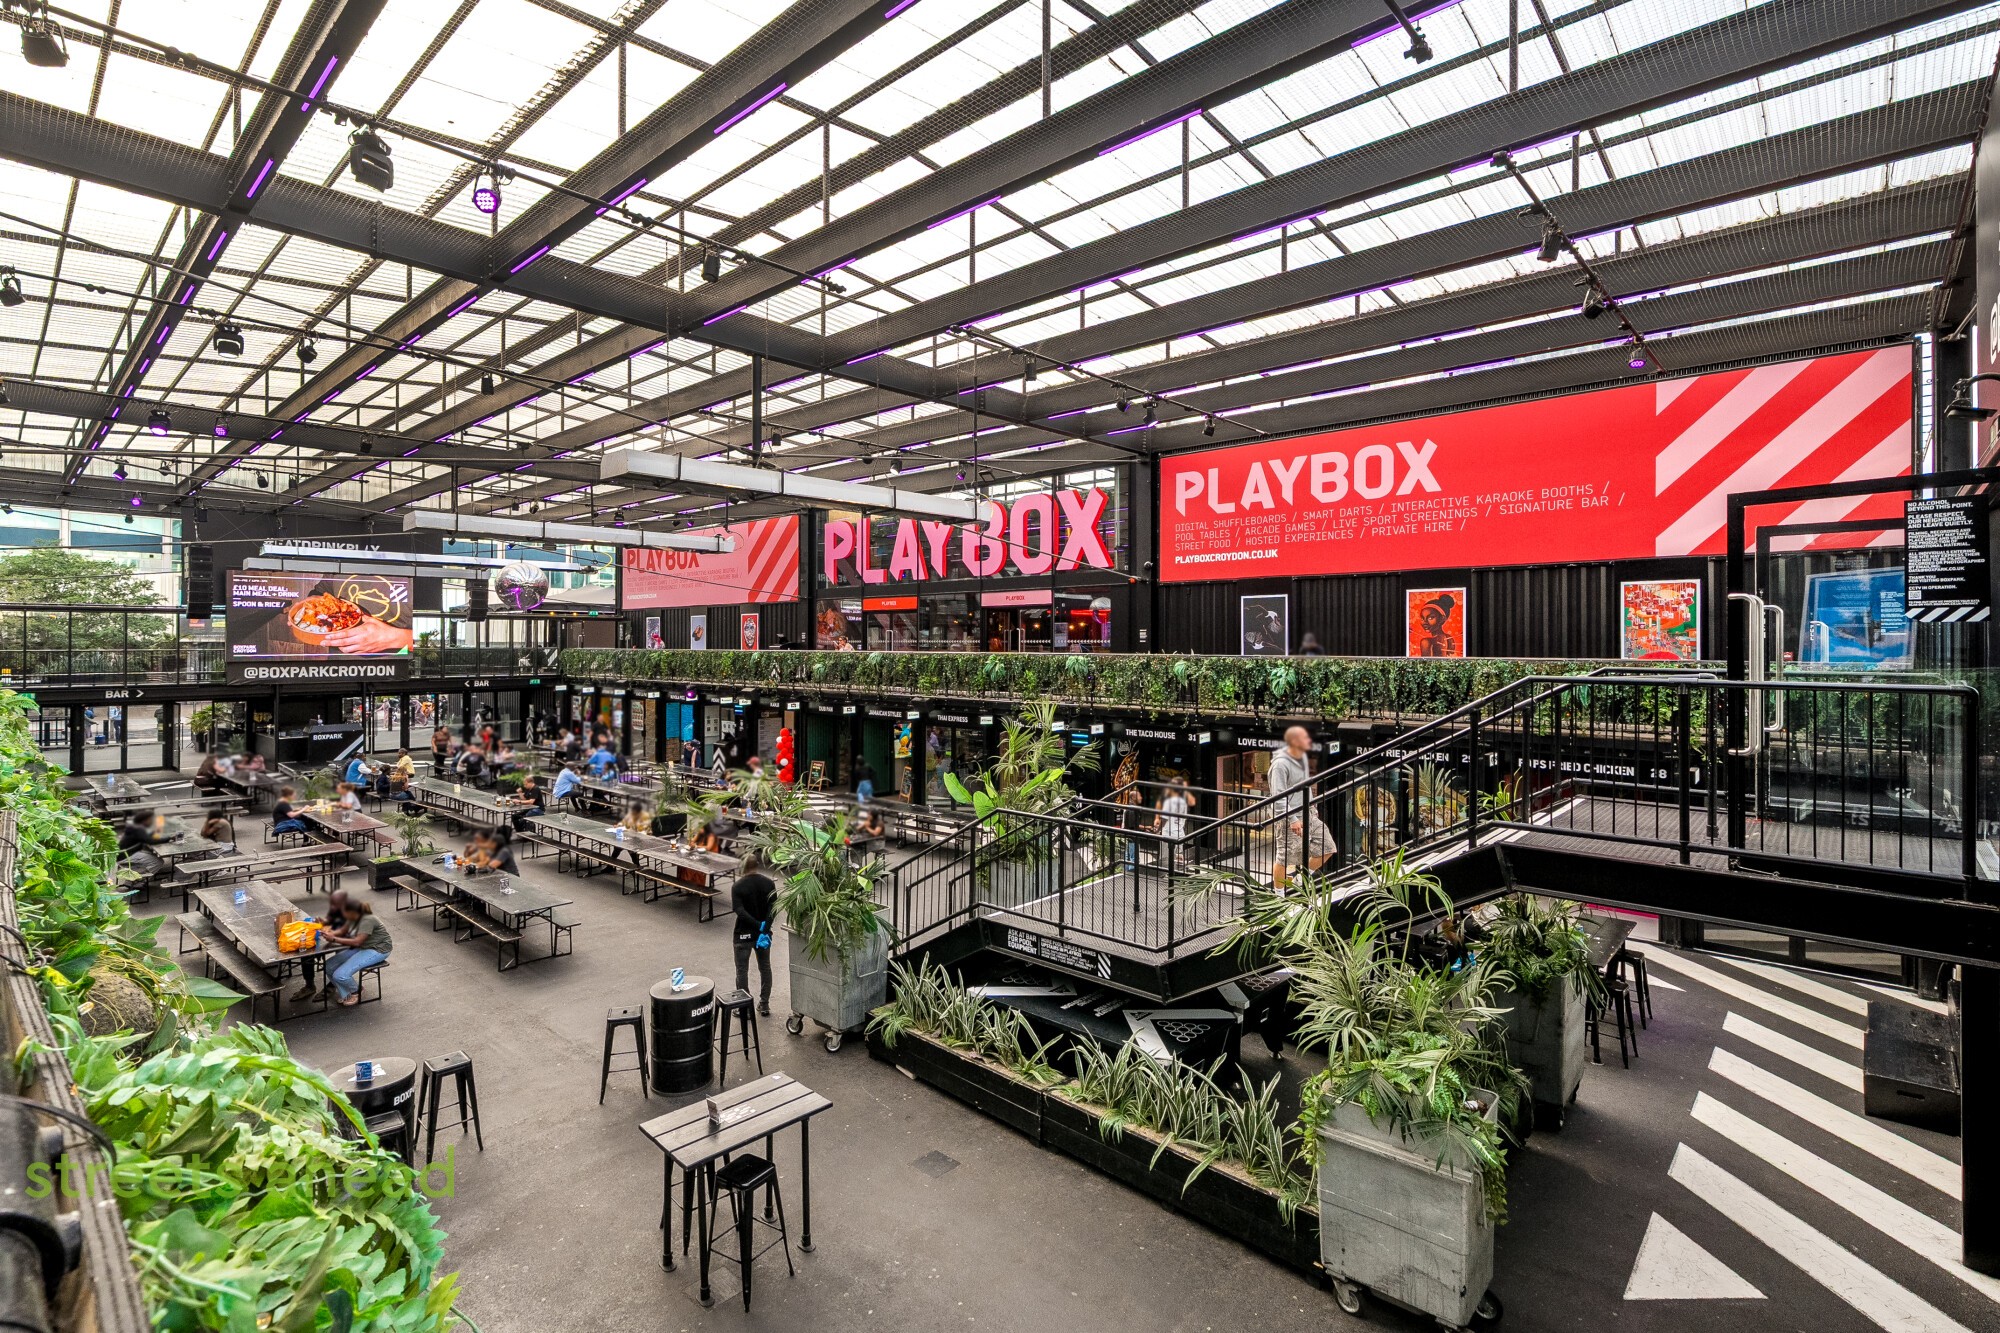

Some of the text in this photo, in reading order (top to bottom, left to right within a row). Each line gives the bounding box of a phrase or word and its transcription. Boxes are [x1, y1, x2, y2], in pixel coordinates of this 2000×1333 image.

[1176, 439, 1441, 516] PLAYBOX
[1175, 523, 1209, 532] DIGITAL
[1213, 514, 1287, 529] SHUFFLEBOARDS
[1303, 510, 1333, 521] SMART
[1340, 506, 1372, 518] DARTS
[1391, 496, 1469, 513] INTERACTIVE
[1476, 490, 1533, 504] KARAOKE
[1541, 484, 1593, 499] BOOTHS
[1175, 532, 1196, 541] POOL
[1199, 529, 1230, 540] TABLES
[1245, 525, 1280, 536] ARCADE
[1285, 522, 1316, 533] GAMES
[1333, 517, 1357, 529] LIVE
[1363, 514, 1396, 526] SPORT
[1404, 508, 1478, 523] SCREENINGS
[1499, 498, 1573, 514] SIGNATURE
[1581, 496, 1609, 508] BAR
[824, 487, 1114, 585] PLAYBOX
[1175, 541, 1204, 551] STREET
[1209, 539, 1231, 549] FOOD
[1245, 534, 1280, 546] HOSTED
[1284, 529, 1353, 543] EXPERIENCES
[1372, 524, 1418, 537] PRIVATE
[1424, 522, 1453, 532] HIRE
[626, 549, 700, 574] PLAYBOX
[1175, 549, 1278, 564] PLAYBOXCROYDON.CO.UK
[1005, 594, 1025, 602] PLAYBOX
[244, 665, 395, 679] @BOXPARKCROYDON
[474, 680, 489, 688] BAR
[105, 690, 129, 699] BAR
[948, 715, 968, 723] EXPRESS
[313, 733, 343, 741] BOXPARK
[1126, 729, 1137, 737] THE
[1138, 729, 1154, 737] TACO
[1154, 731, 1176, 740] HOUSE
[1188, 733, 1196, 741] 31
[1238, 738, 1257, 747] LOVE
[1518, 758, 1546, 769] PPS
[1549, 760, 1581, 772] FRIED
[1584, 763, 1635, 777] CHICKEN
[1008, 928, 1019, 937] ASK
[1026, 933, 1037, 942] BAR
[1008, 935, 1033, 947] FOR POOL
[1008, 941, 1037, 955] EQUIPMENT
[1041, 942, 1059, 950] UPSTAIRS
